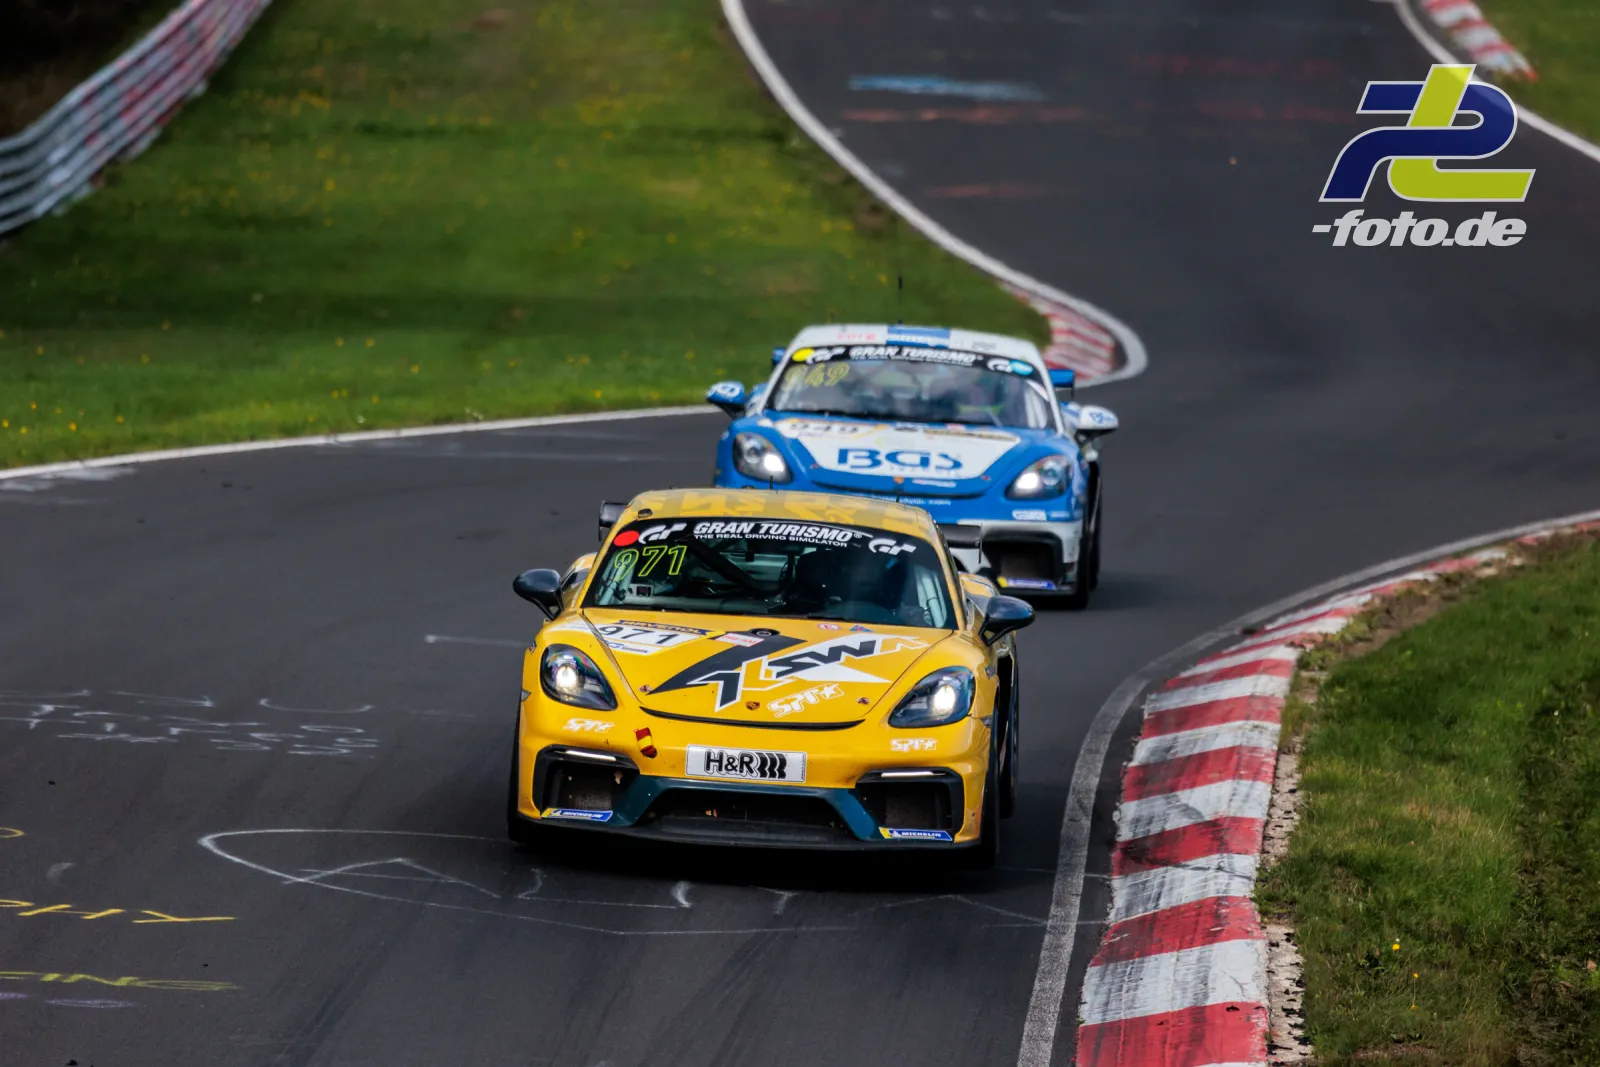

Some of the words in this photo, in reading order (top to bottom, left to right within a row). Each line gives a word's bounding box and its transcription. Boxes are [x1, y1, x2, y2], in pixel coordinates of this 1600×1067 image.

[850, 346, 899, 359] GRAN
[693, 521, 754, 534] GRAN
[745, 533, 787, 541] DRIVING
[788, 536, 848, 548] SIMULATOR
[613, 545, 687, 581] 971
[600, 625, 679, 645] 971
[704, 749, 758, 777] H&R
[901, 831, 941, 839] MICHELIN
